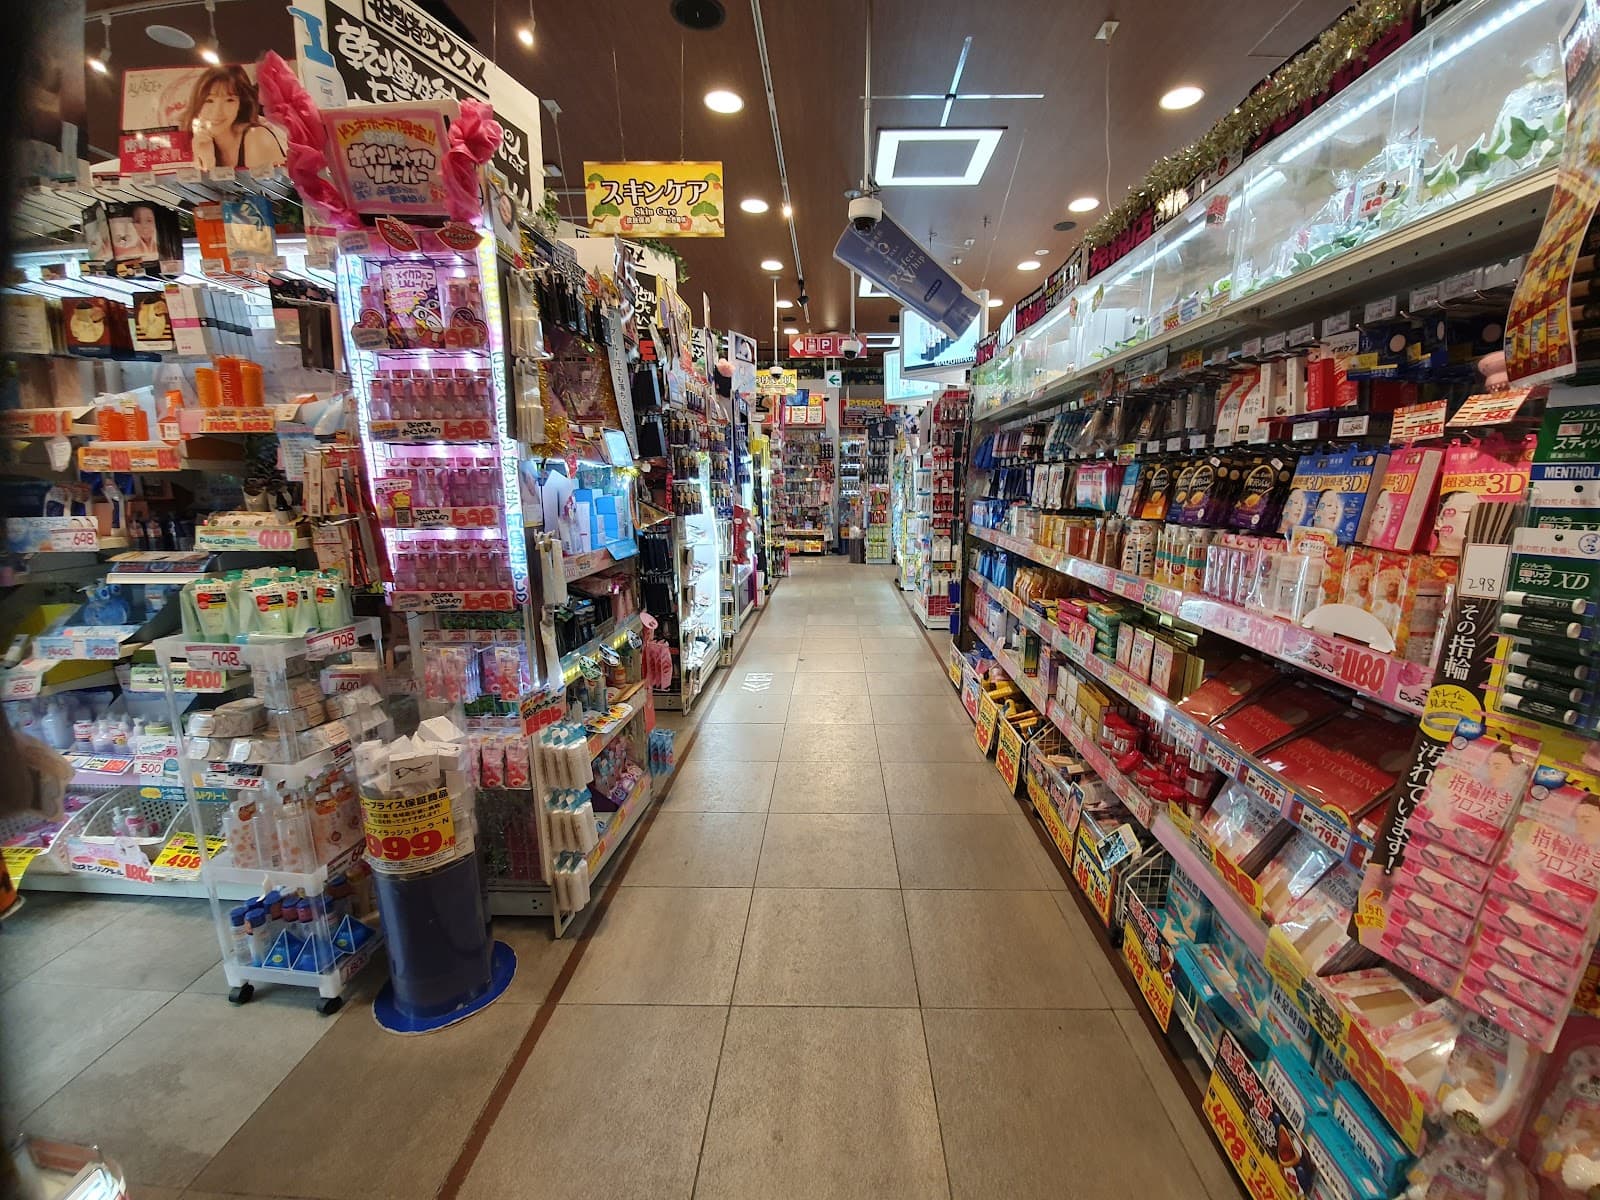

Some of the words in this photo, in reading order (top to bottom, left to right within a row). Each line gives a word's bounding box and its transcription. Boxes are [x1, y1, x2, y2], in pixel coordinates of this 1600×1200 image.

[600, 178, 709, 206] スキンケア
[634, 207, 654, 216] Skin
[656, 207, 677, 216] Care
[1544, 466, 1600, 480] MENTHOL
[73, 532, 95, 546] 698
[1467, 577, 1496, 592] 298
[1553, 573, 1590, 590] XD
[333, 632, 355, 651] 798
[1443, 603, 1480, 681] その指輪
[211, 651, 240, 666] 798
[140, 762, 162, 774] 500
[1448, 773, 1513, 809] 指輪磨き
[166, 854, 202, 869] 498
